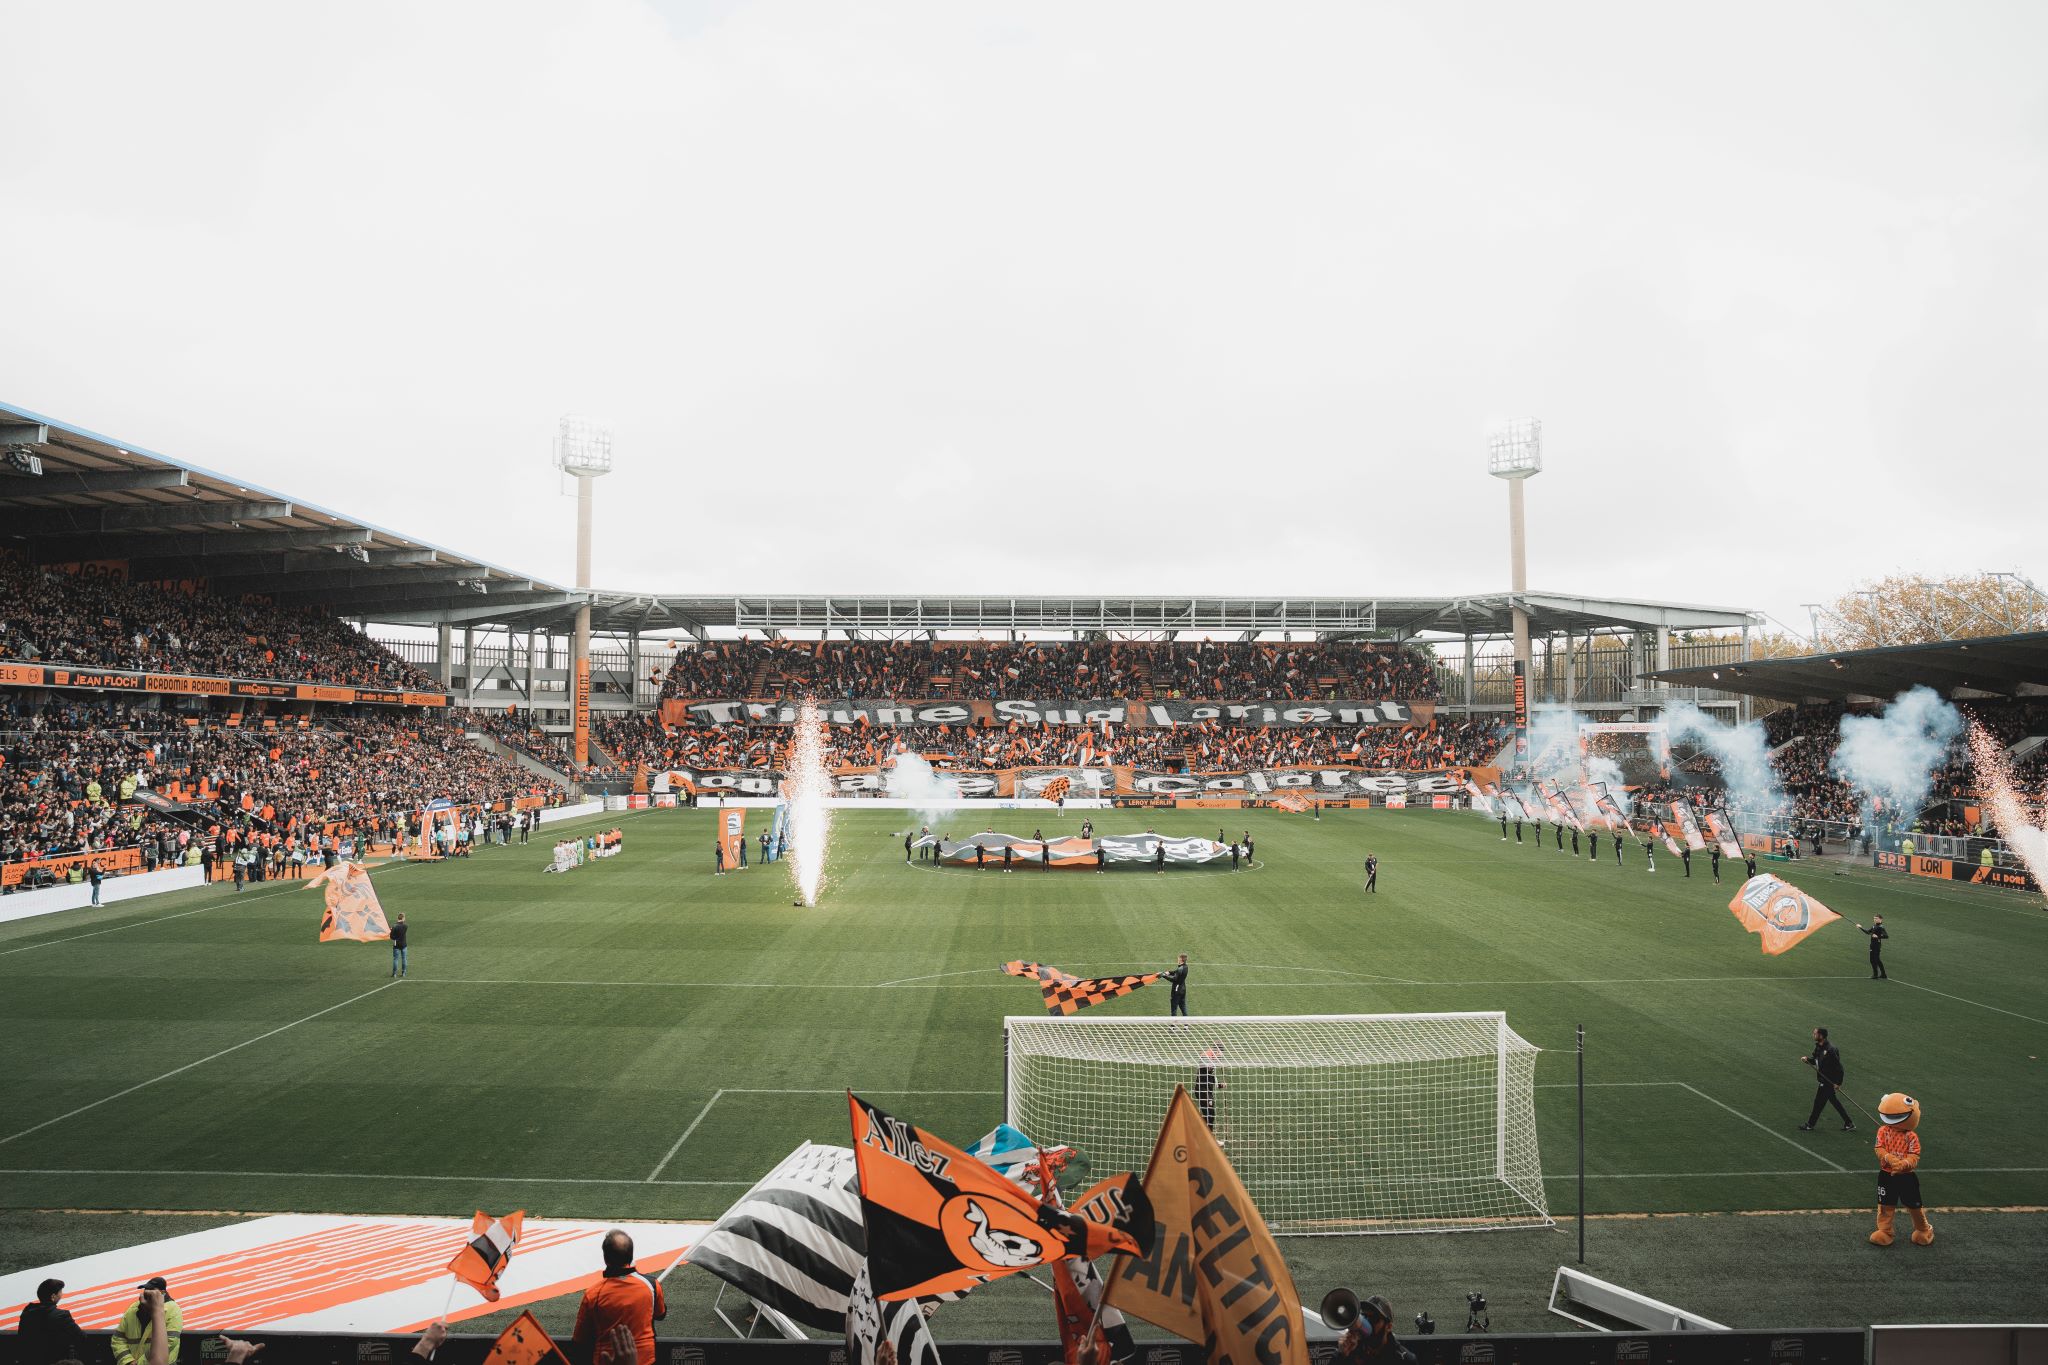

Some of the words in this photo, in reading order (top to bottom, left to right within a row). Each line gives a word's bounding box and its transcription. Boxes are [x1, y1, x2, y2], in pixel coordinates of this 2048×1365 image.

[73, 673, 101, 686] JEAN
[103, 675, 138, 688] FLOCH
[148, 677, 188, 691] ACADOMIA
[192, 679, 229, 693] ACADOMIA
[1514, 674, 1525, 714] LORIENT
[995, 700, 1124, 724] Sud
[1515, 716, 1526, 729] FC
[1878, 851, 1907, 867] SRB
[1920, 858, 1942, 874] LORI
[862, 1108, 955, 1184] Allez
